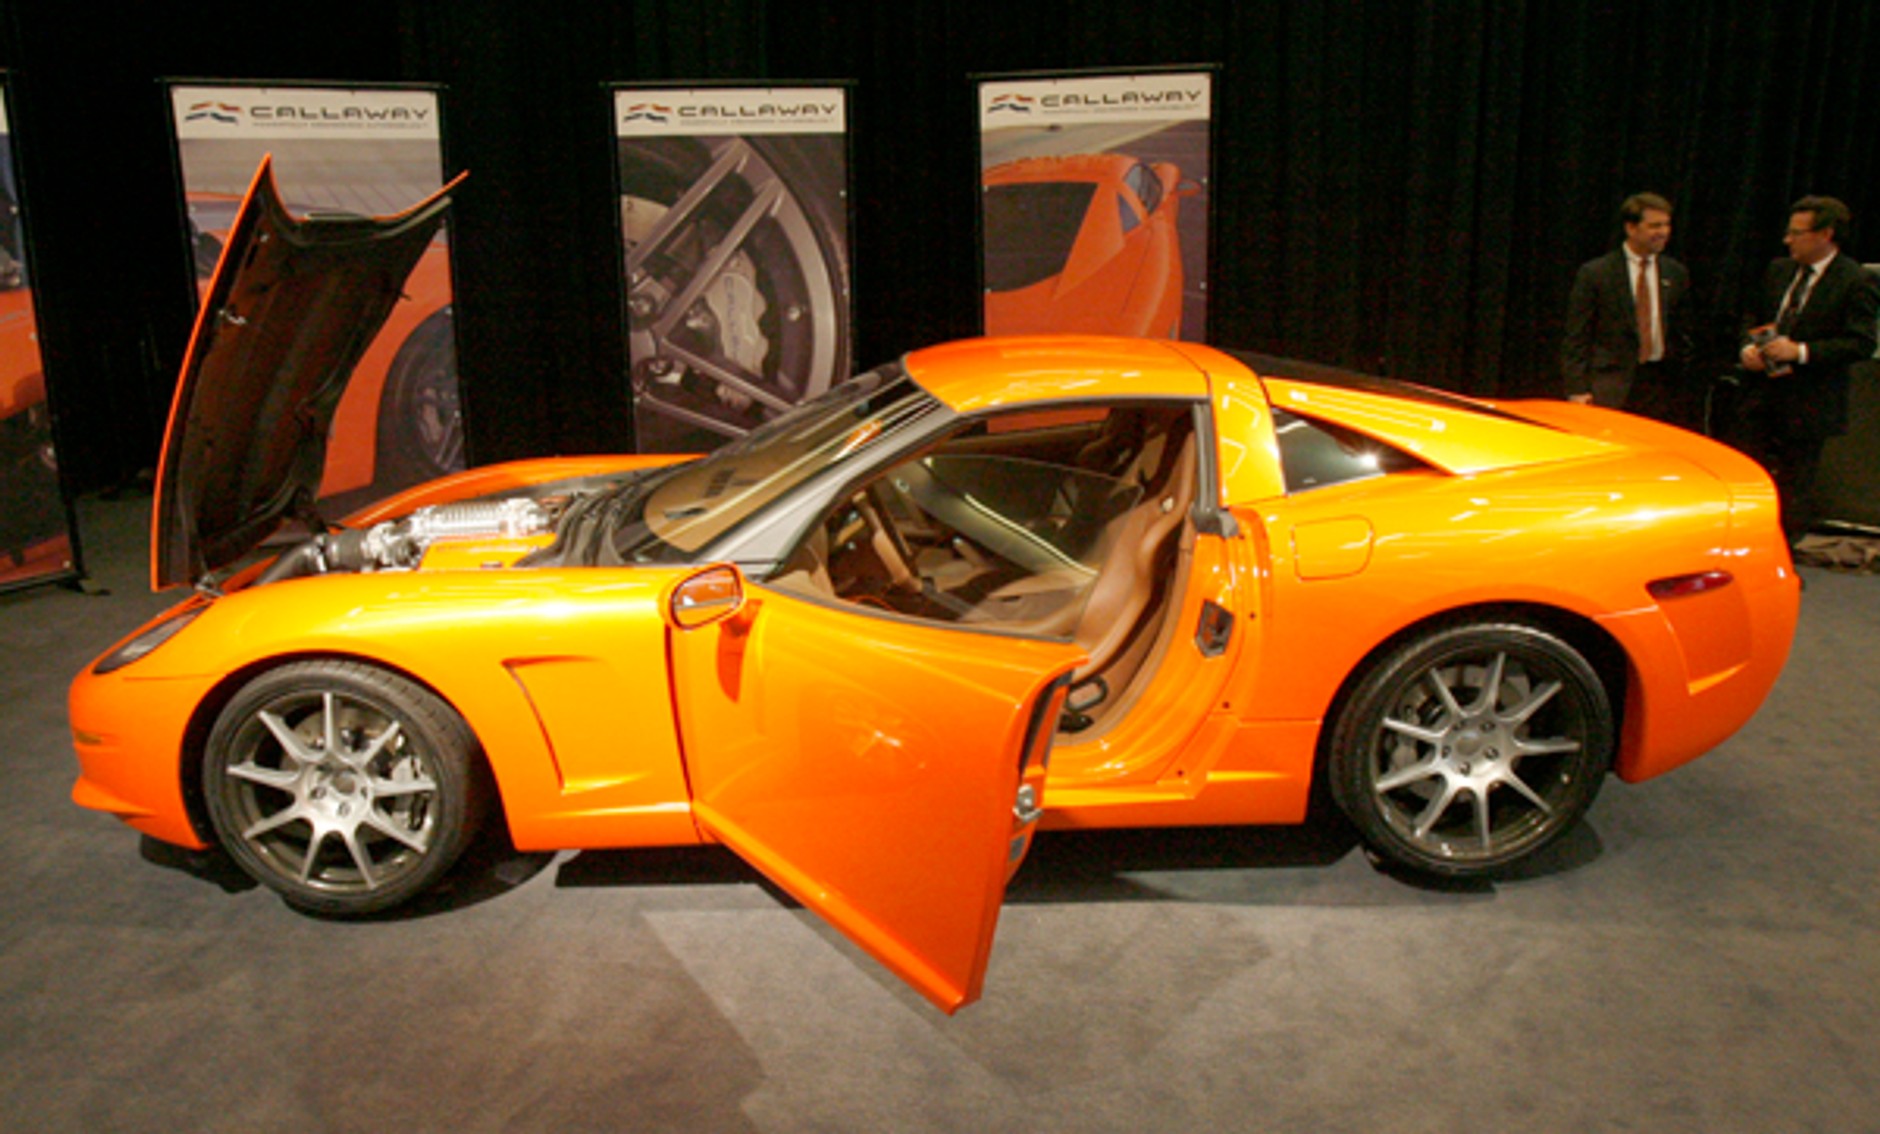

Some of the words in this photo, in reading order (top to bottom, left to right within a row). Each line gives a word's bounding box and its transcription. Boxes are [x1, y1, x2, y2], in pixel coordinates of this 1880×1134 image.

[1040, 90, 1201, 107] CALLAWAY
[250, 106, 428, 120] CALLAWAY
[676, 103, 837, 117] CALLAWAY
